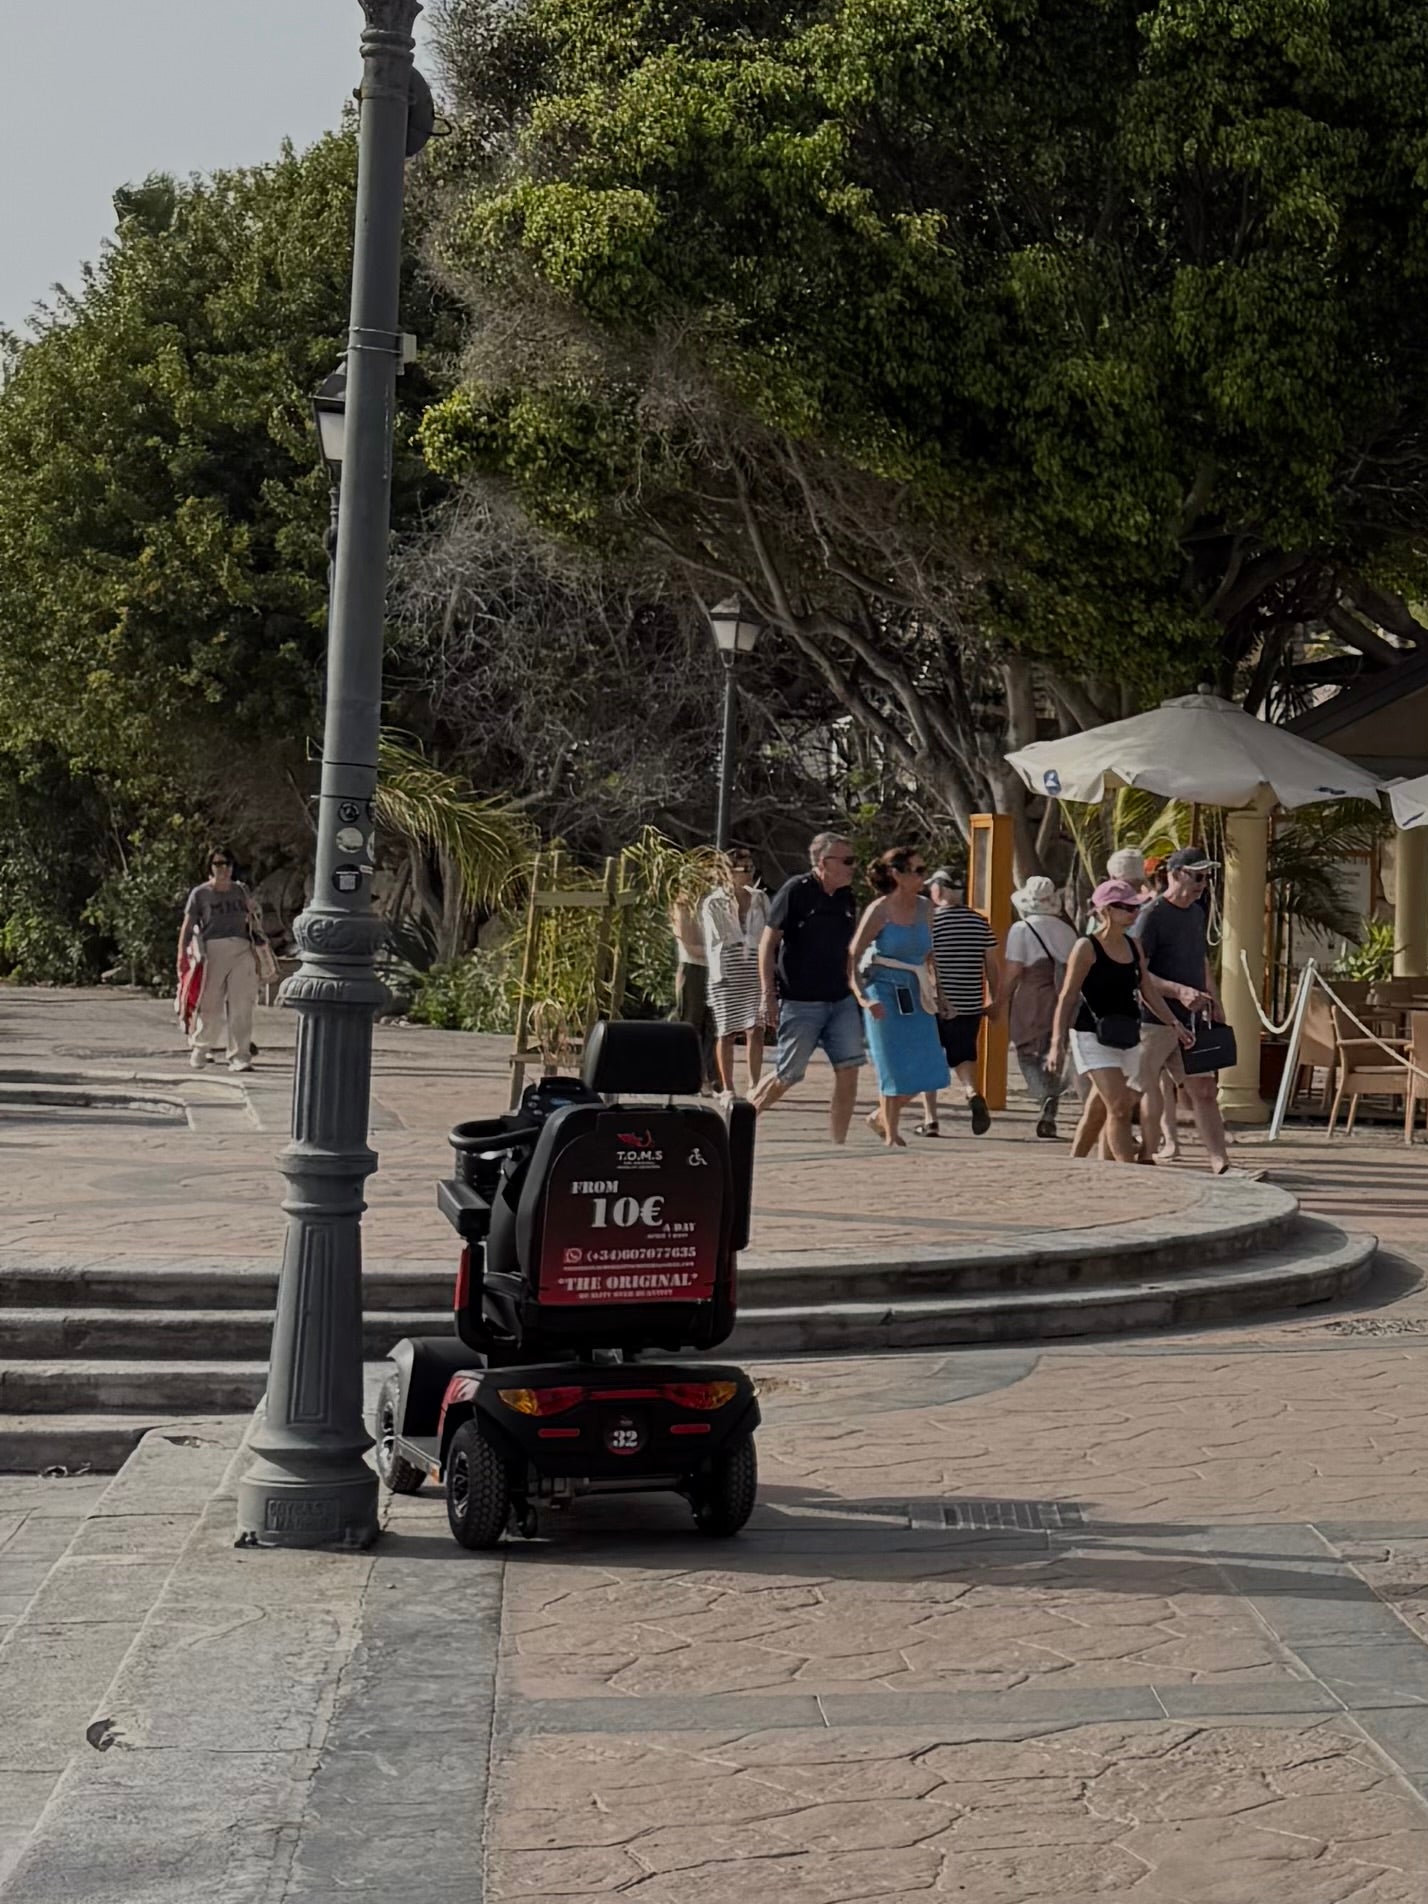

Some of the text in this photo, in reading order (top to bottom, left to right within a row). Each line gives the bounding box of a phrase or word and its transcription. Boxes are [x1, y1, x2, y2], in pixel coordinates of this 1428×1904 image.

[571, 1180, 619, 1195] FROM
[591, 1196, 665, 1228] 10€
[673, 1222, 696, 1232] DAY
[612, 1430, 638, 1447] 32
